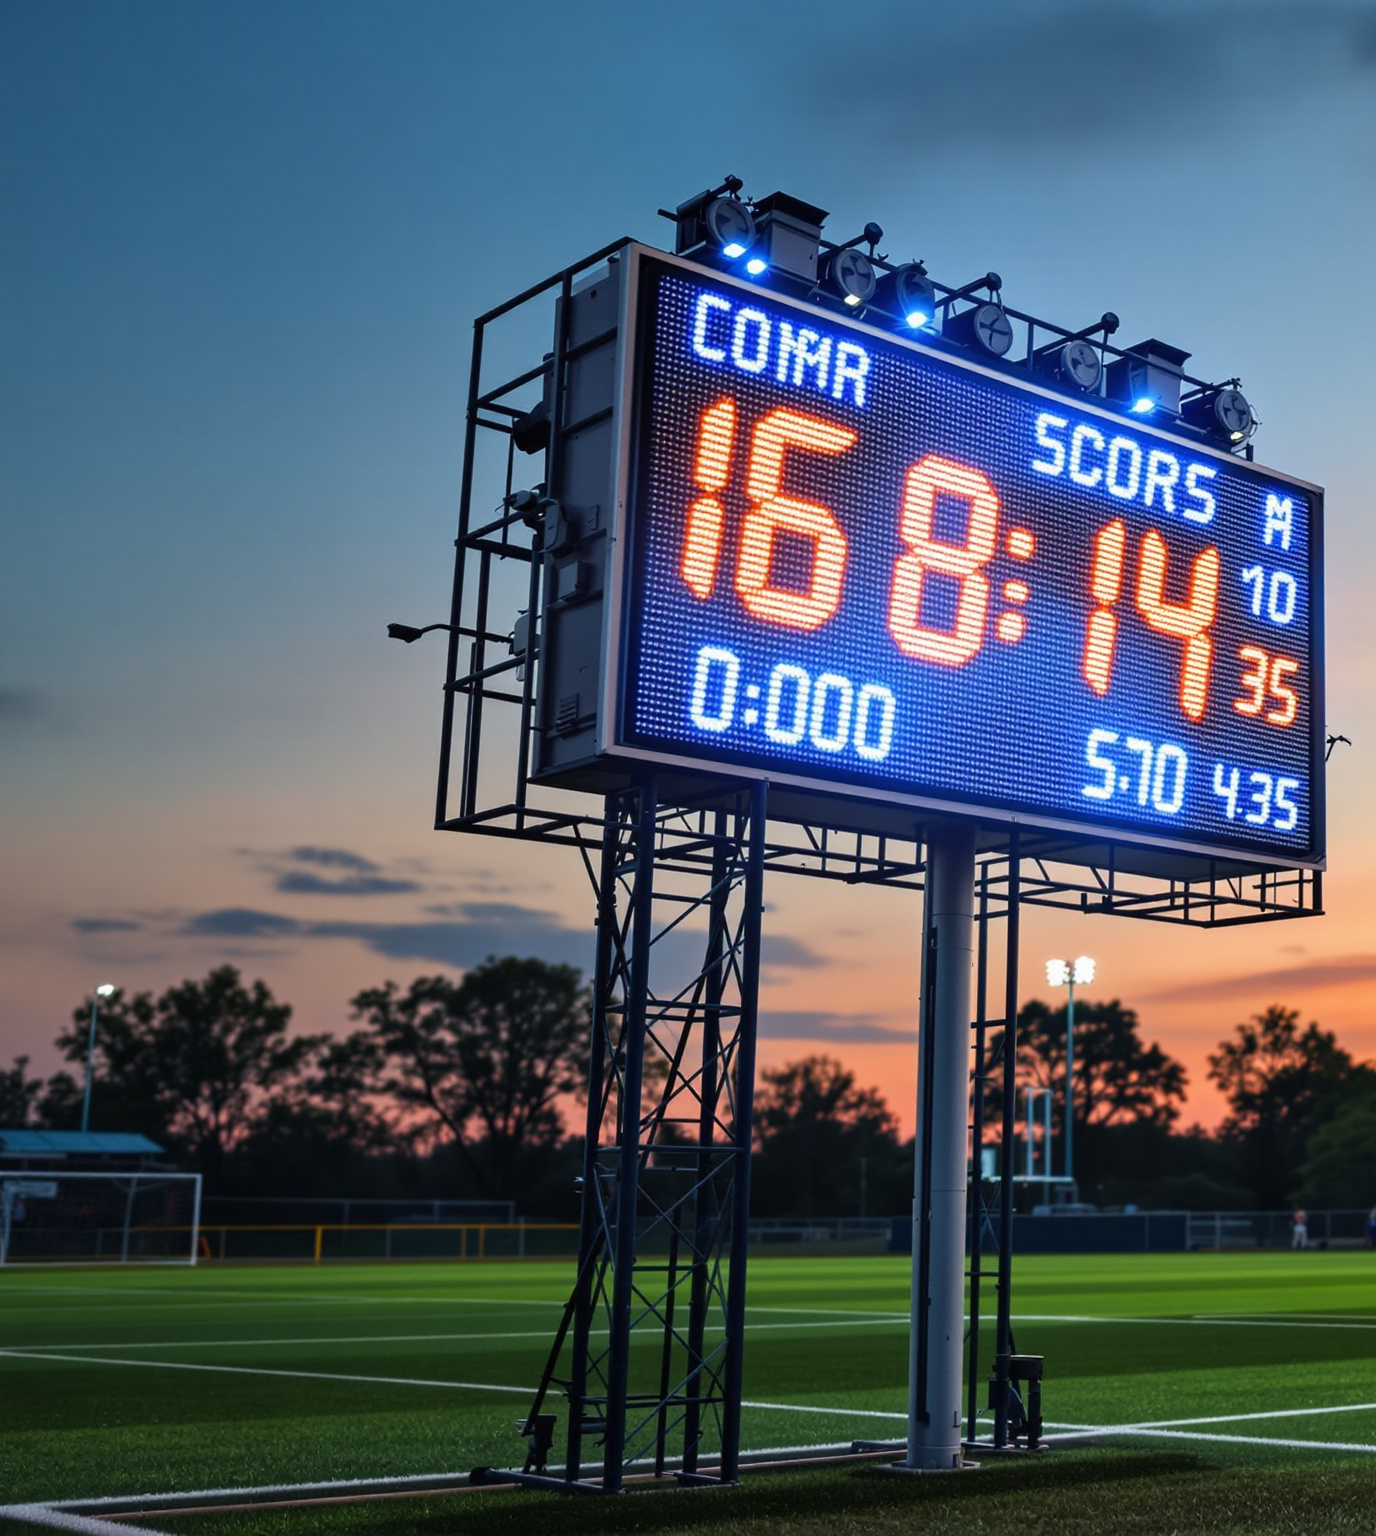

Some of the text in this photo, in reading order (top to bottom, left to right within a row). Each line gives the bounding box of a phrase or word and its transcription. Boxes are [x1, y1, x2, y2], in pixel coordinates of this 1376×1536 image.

[1031, 411, 1218, 525] SCORS
[681, 397, 858, 633] 16
[1241, 564, 1298, 625] 10
[1232, 644, 1299, 727] 35
[1213, 762, 1300, 831] 4.35
